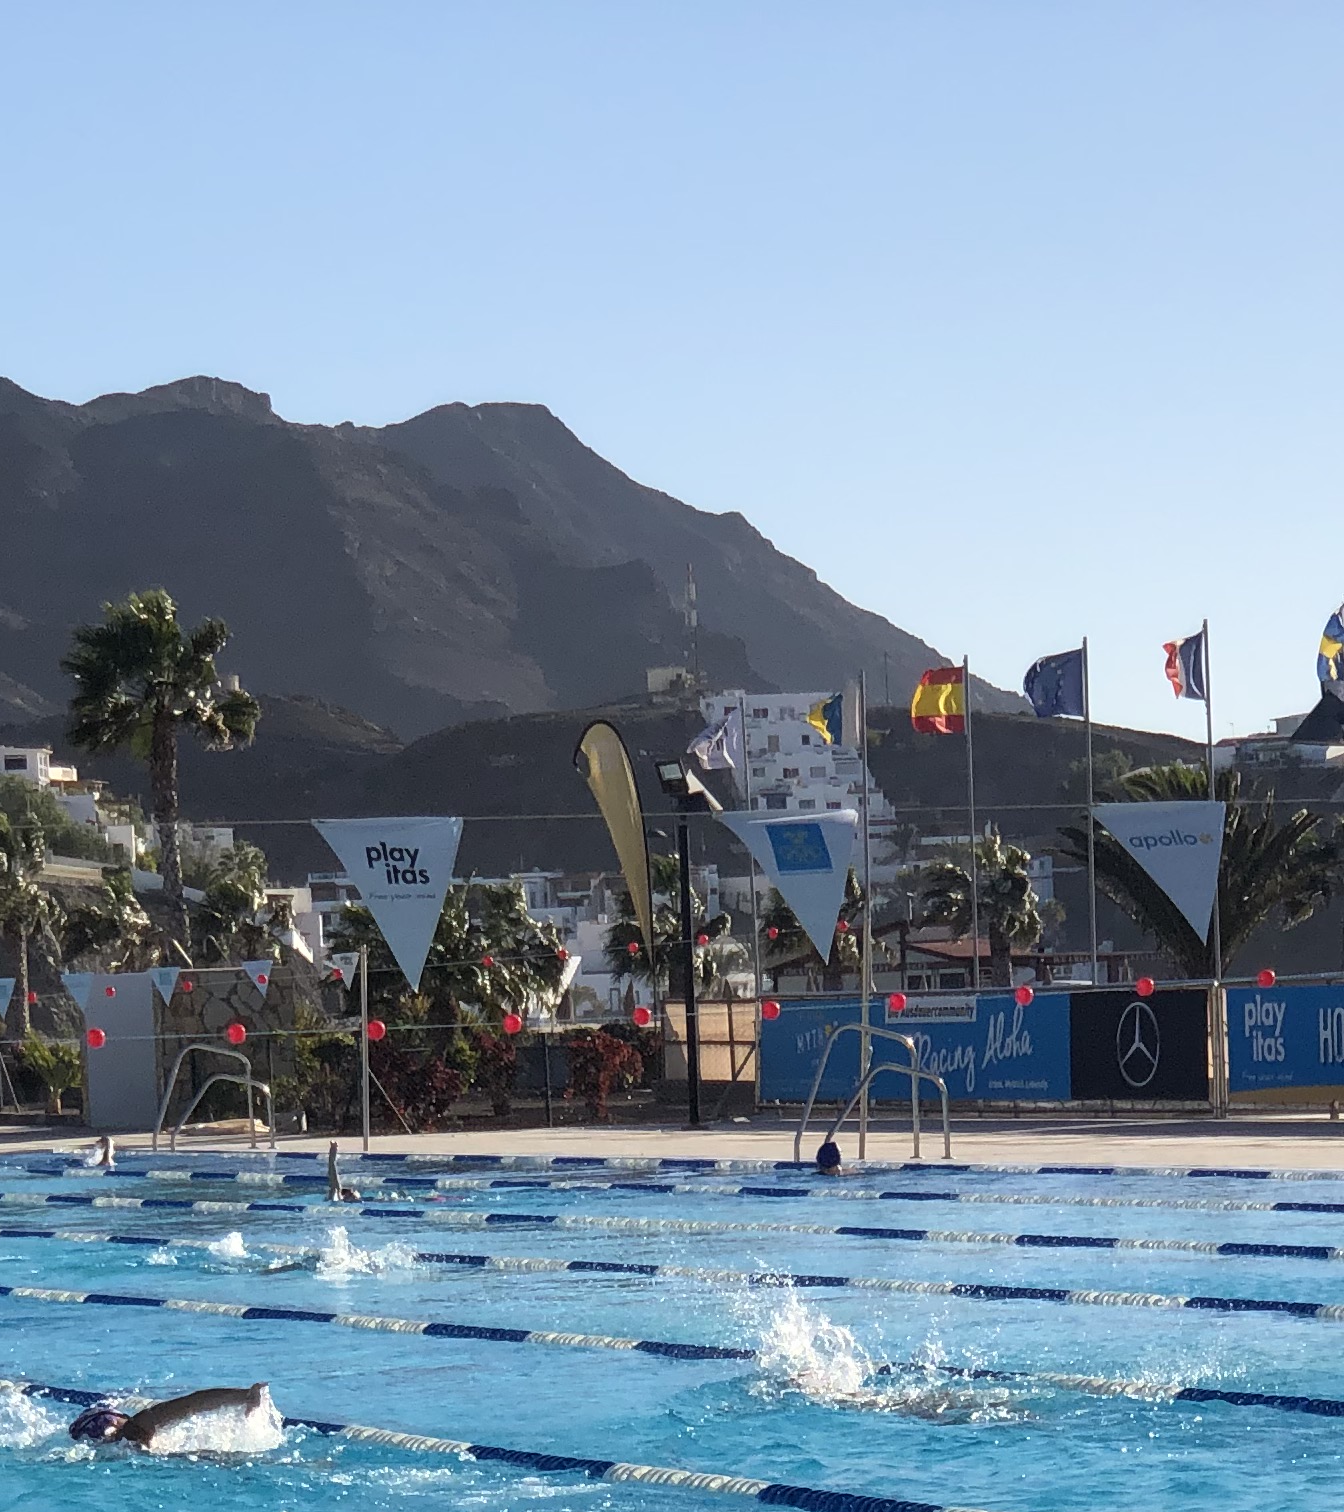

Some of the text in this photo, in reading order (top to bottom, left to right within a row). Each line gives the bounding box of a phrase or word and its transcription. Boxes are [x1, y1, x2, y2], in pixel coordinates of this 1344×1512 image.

[1129, 830, 1198, 850] apollo
[365, 841, 420, 869] play
[384, 863, 430, 885] itas
[1244, 995, 1286, 1036] play
[912, 1004, 1034, 1092] Racing Aloha
[1253, 1031, 1286, 1062] itas
